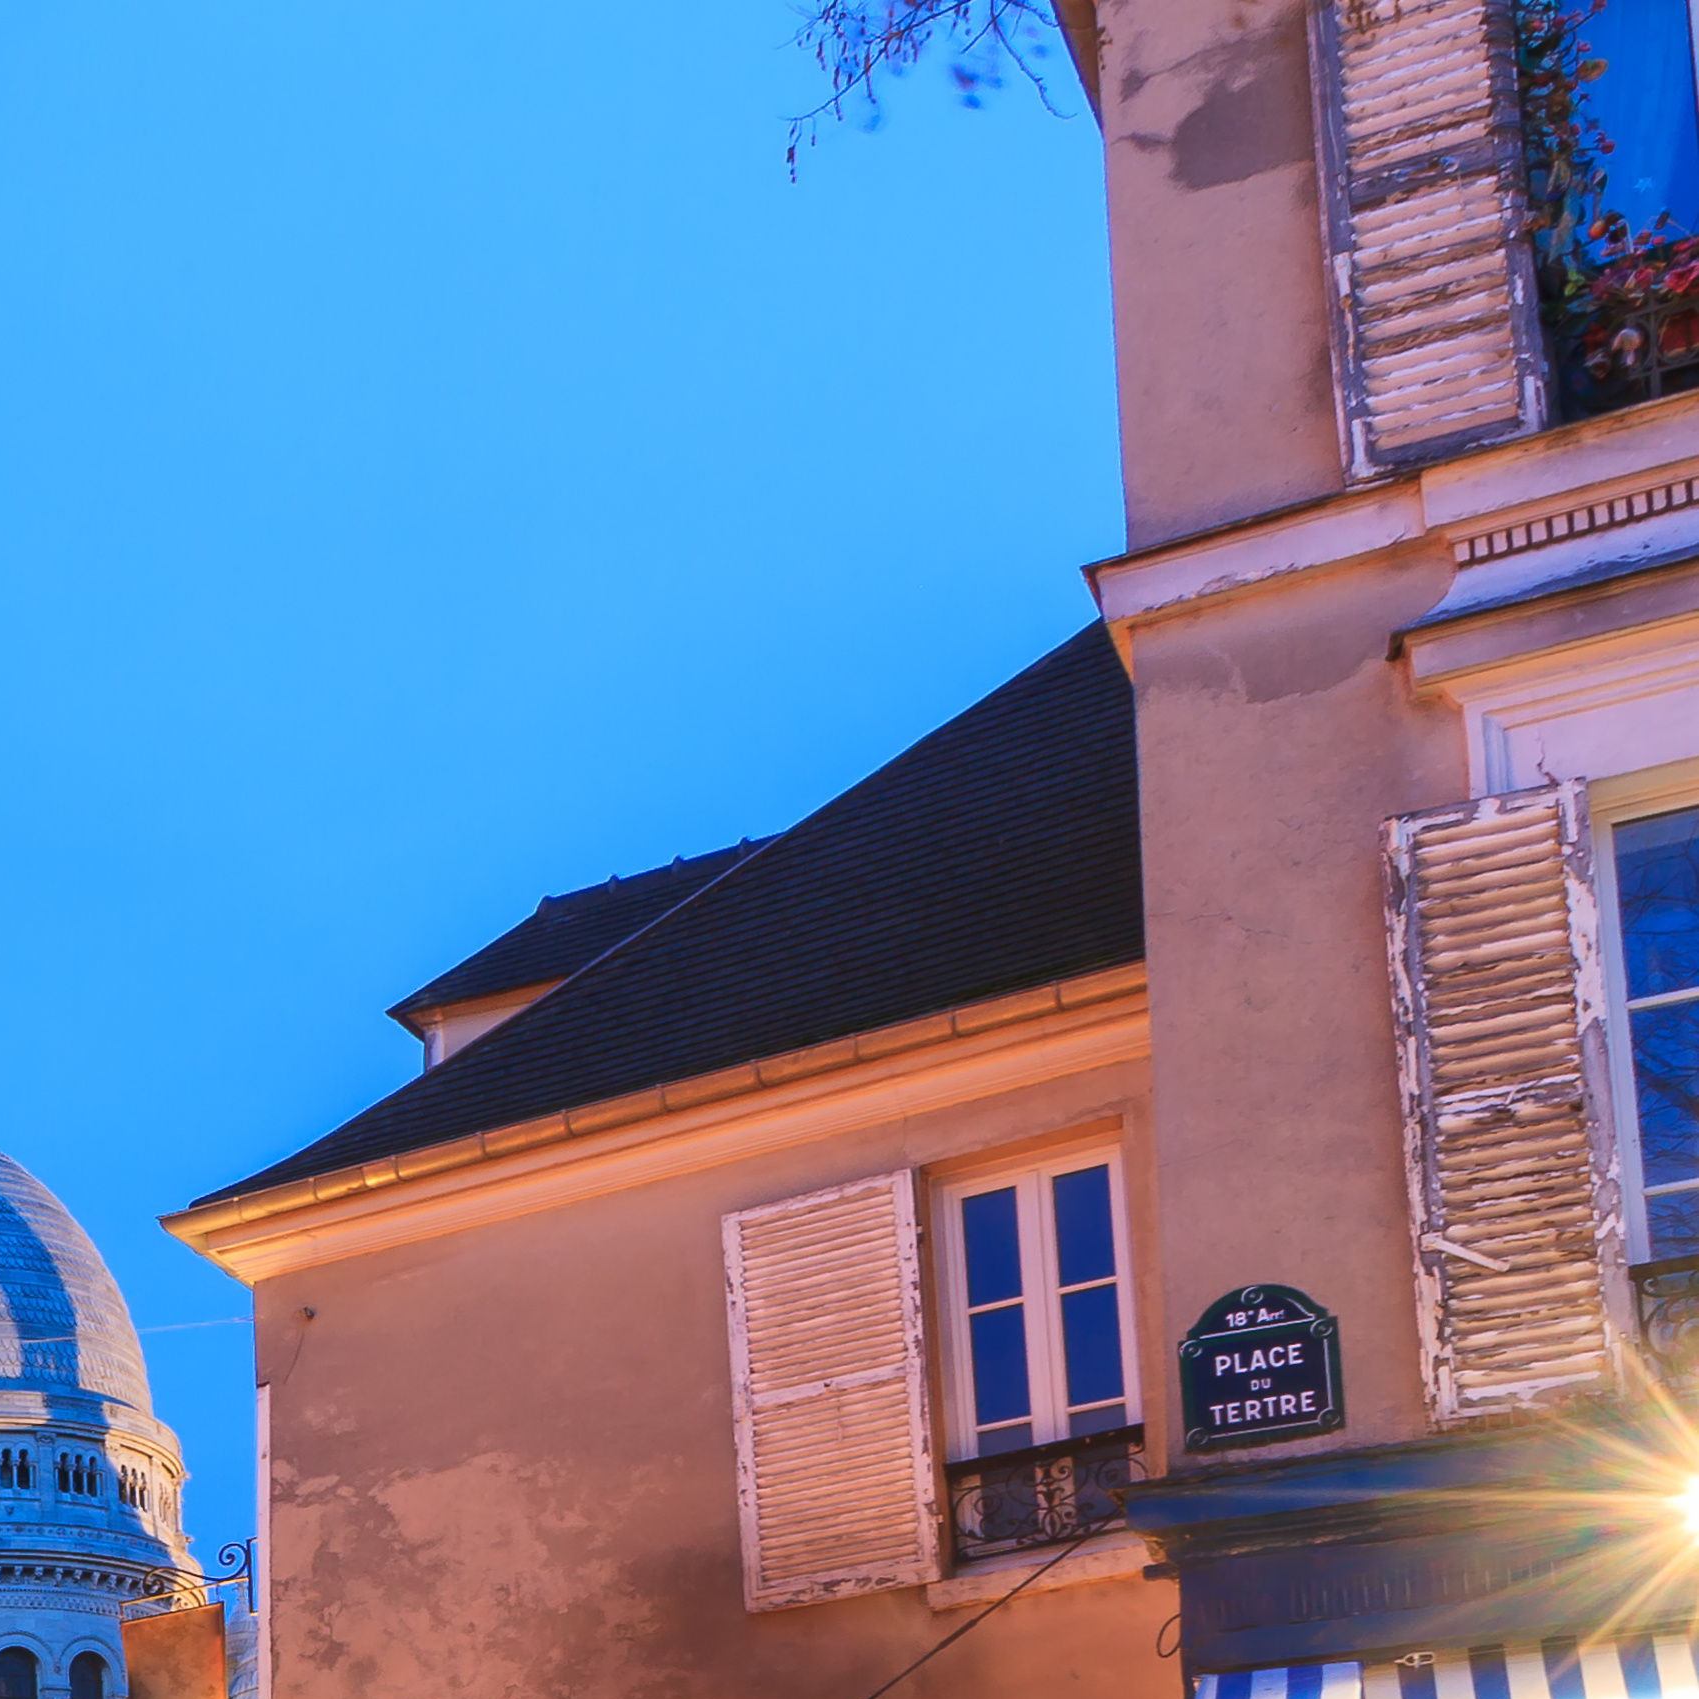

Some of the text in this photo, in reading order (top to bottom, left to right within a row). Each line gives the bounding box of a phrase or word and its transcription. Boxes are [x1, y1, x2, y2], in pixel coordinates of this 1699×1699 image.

[1214, 1343, 1304, 1377] PLACE
[1250, 1377, 1272, 1391] DU
[1208, 1390, 1317, 1426] TERTRE
